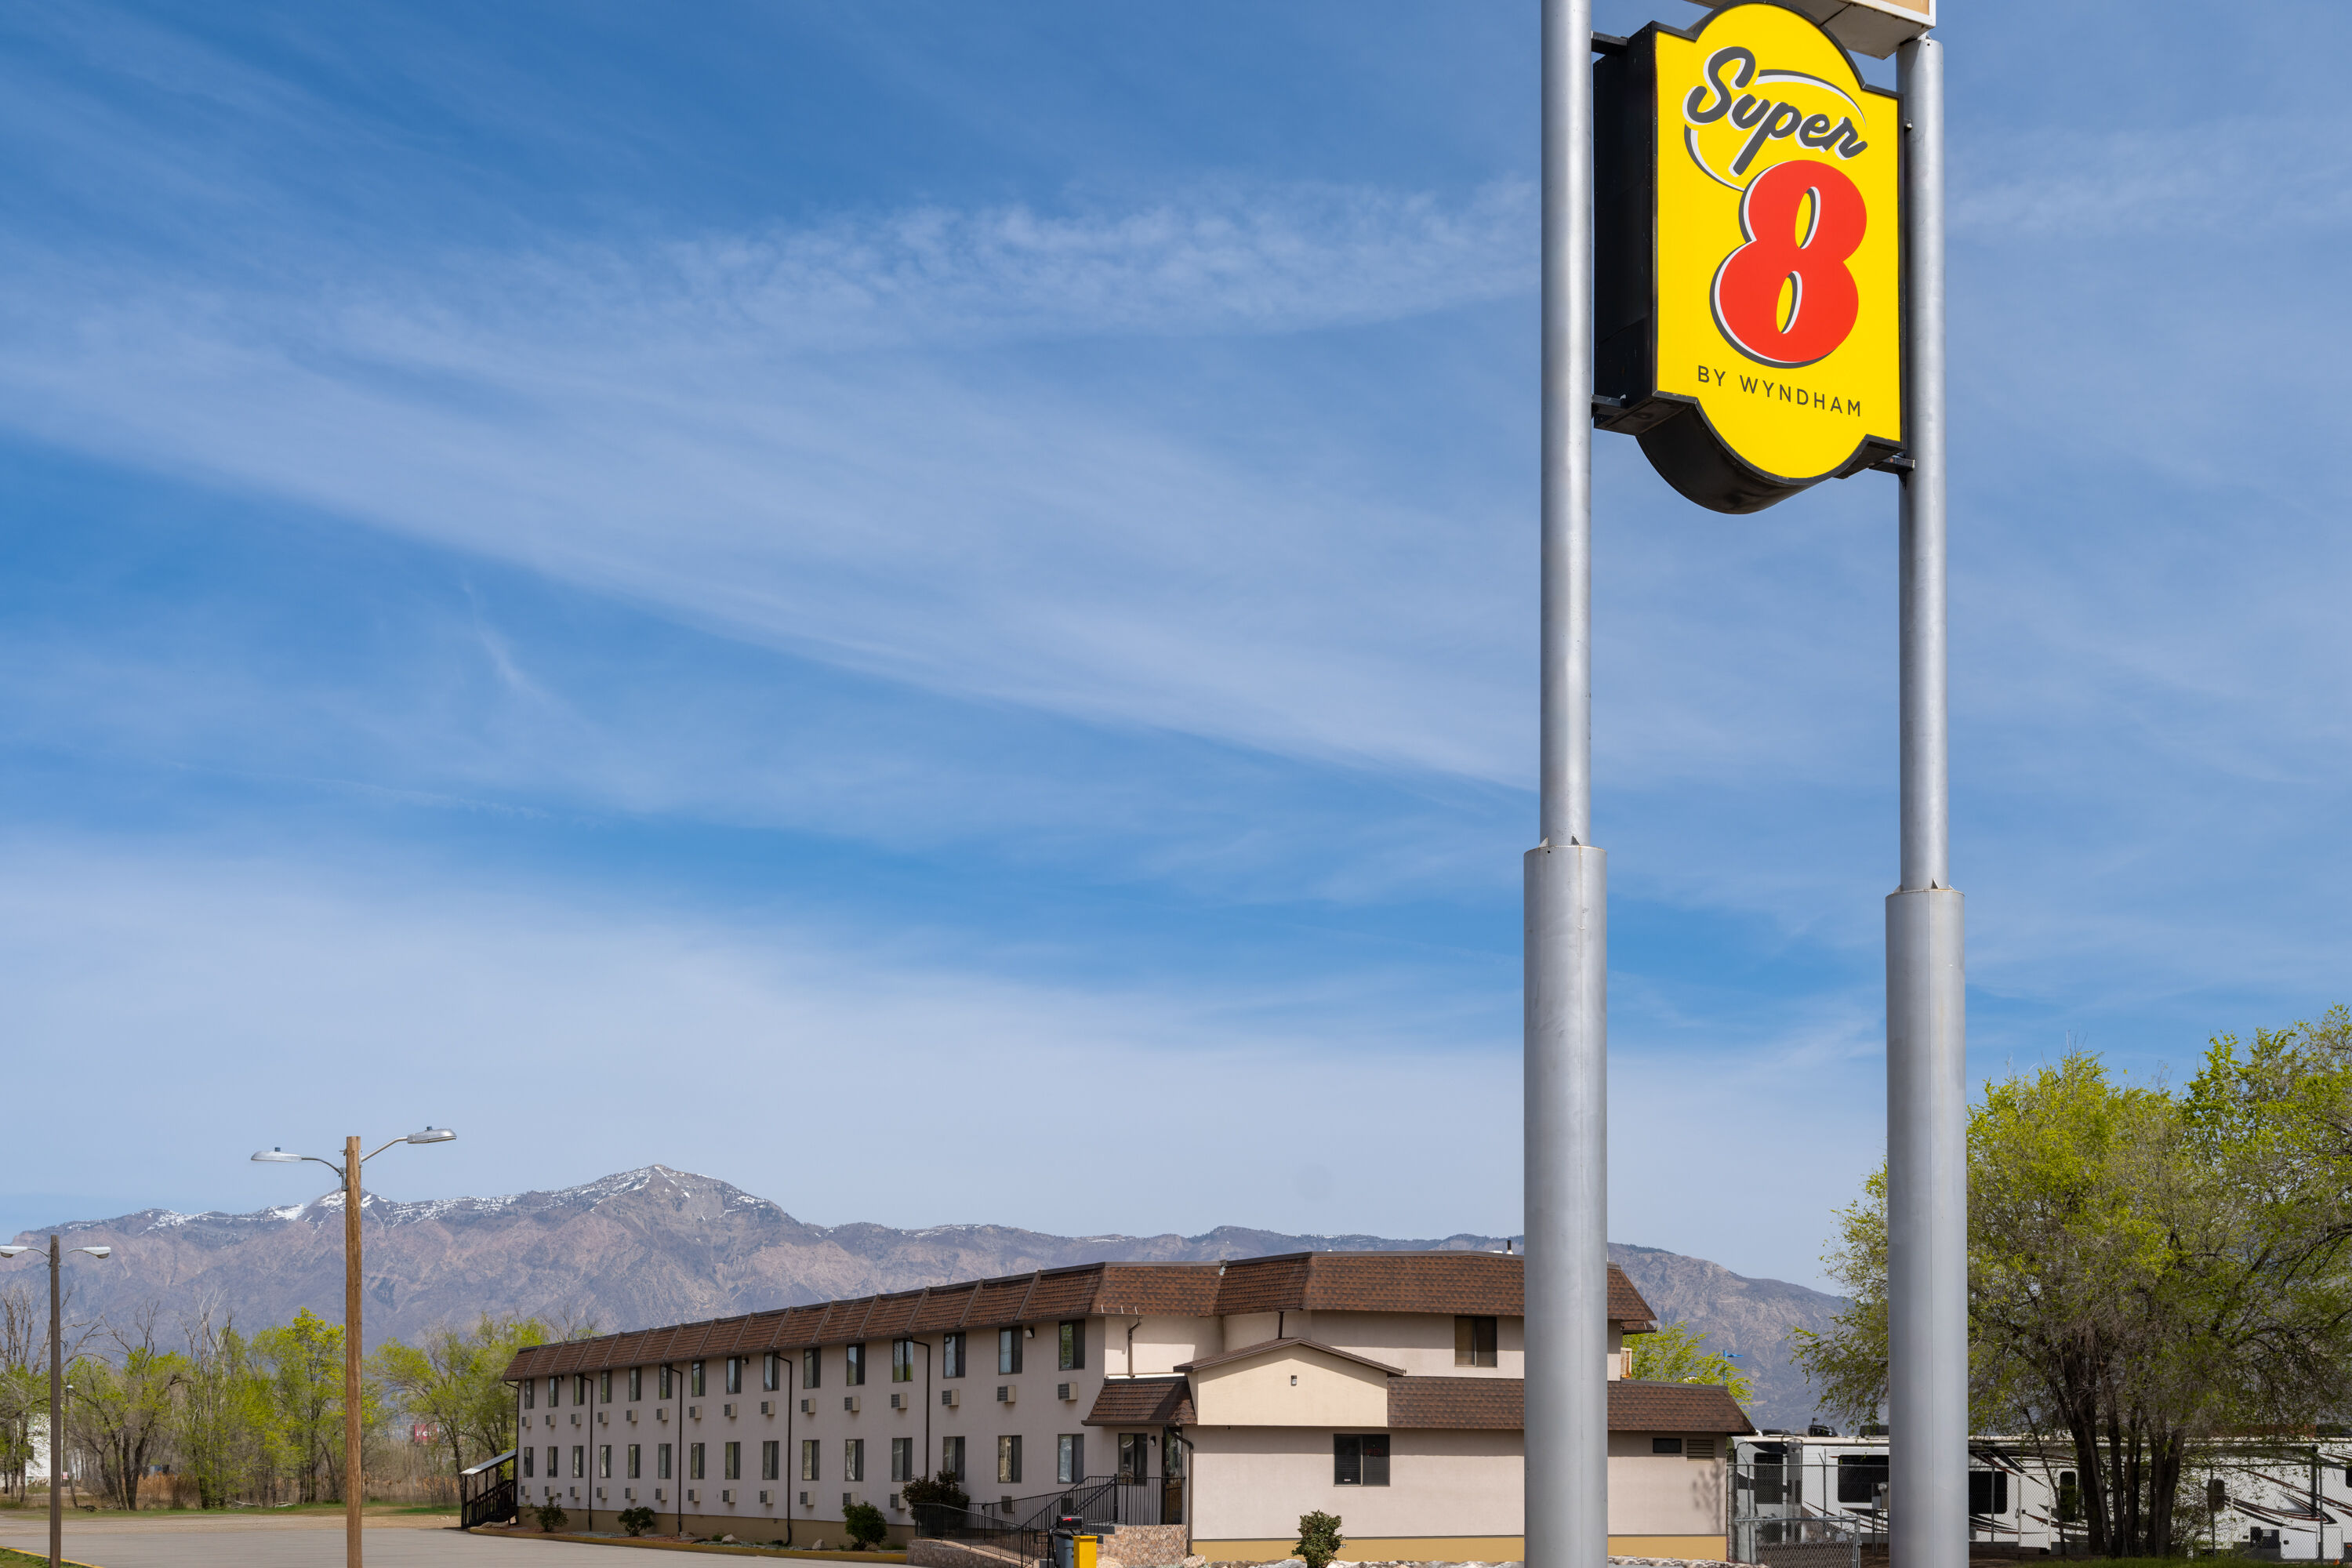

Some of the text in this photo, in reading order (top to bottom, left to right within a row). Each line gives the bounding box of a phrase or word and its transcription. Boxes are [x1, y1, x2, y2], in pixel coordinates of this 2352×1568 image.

[1682, 46, 1867, 177] Super
[1709, 160, 1867, 369] 8
[1698, 365, 1860, 417] BY WYNDHAM
